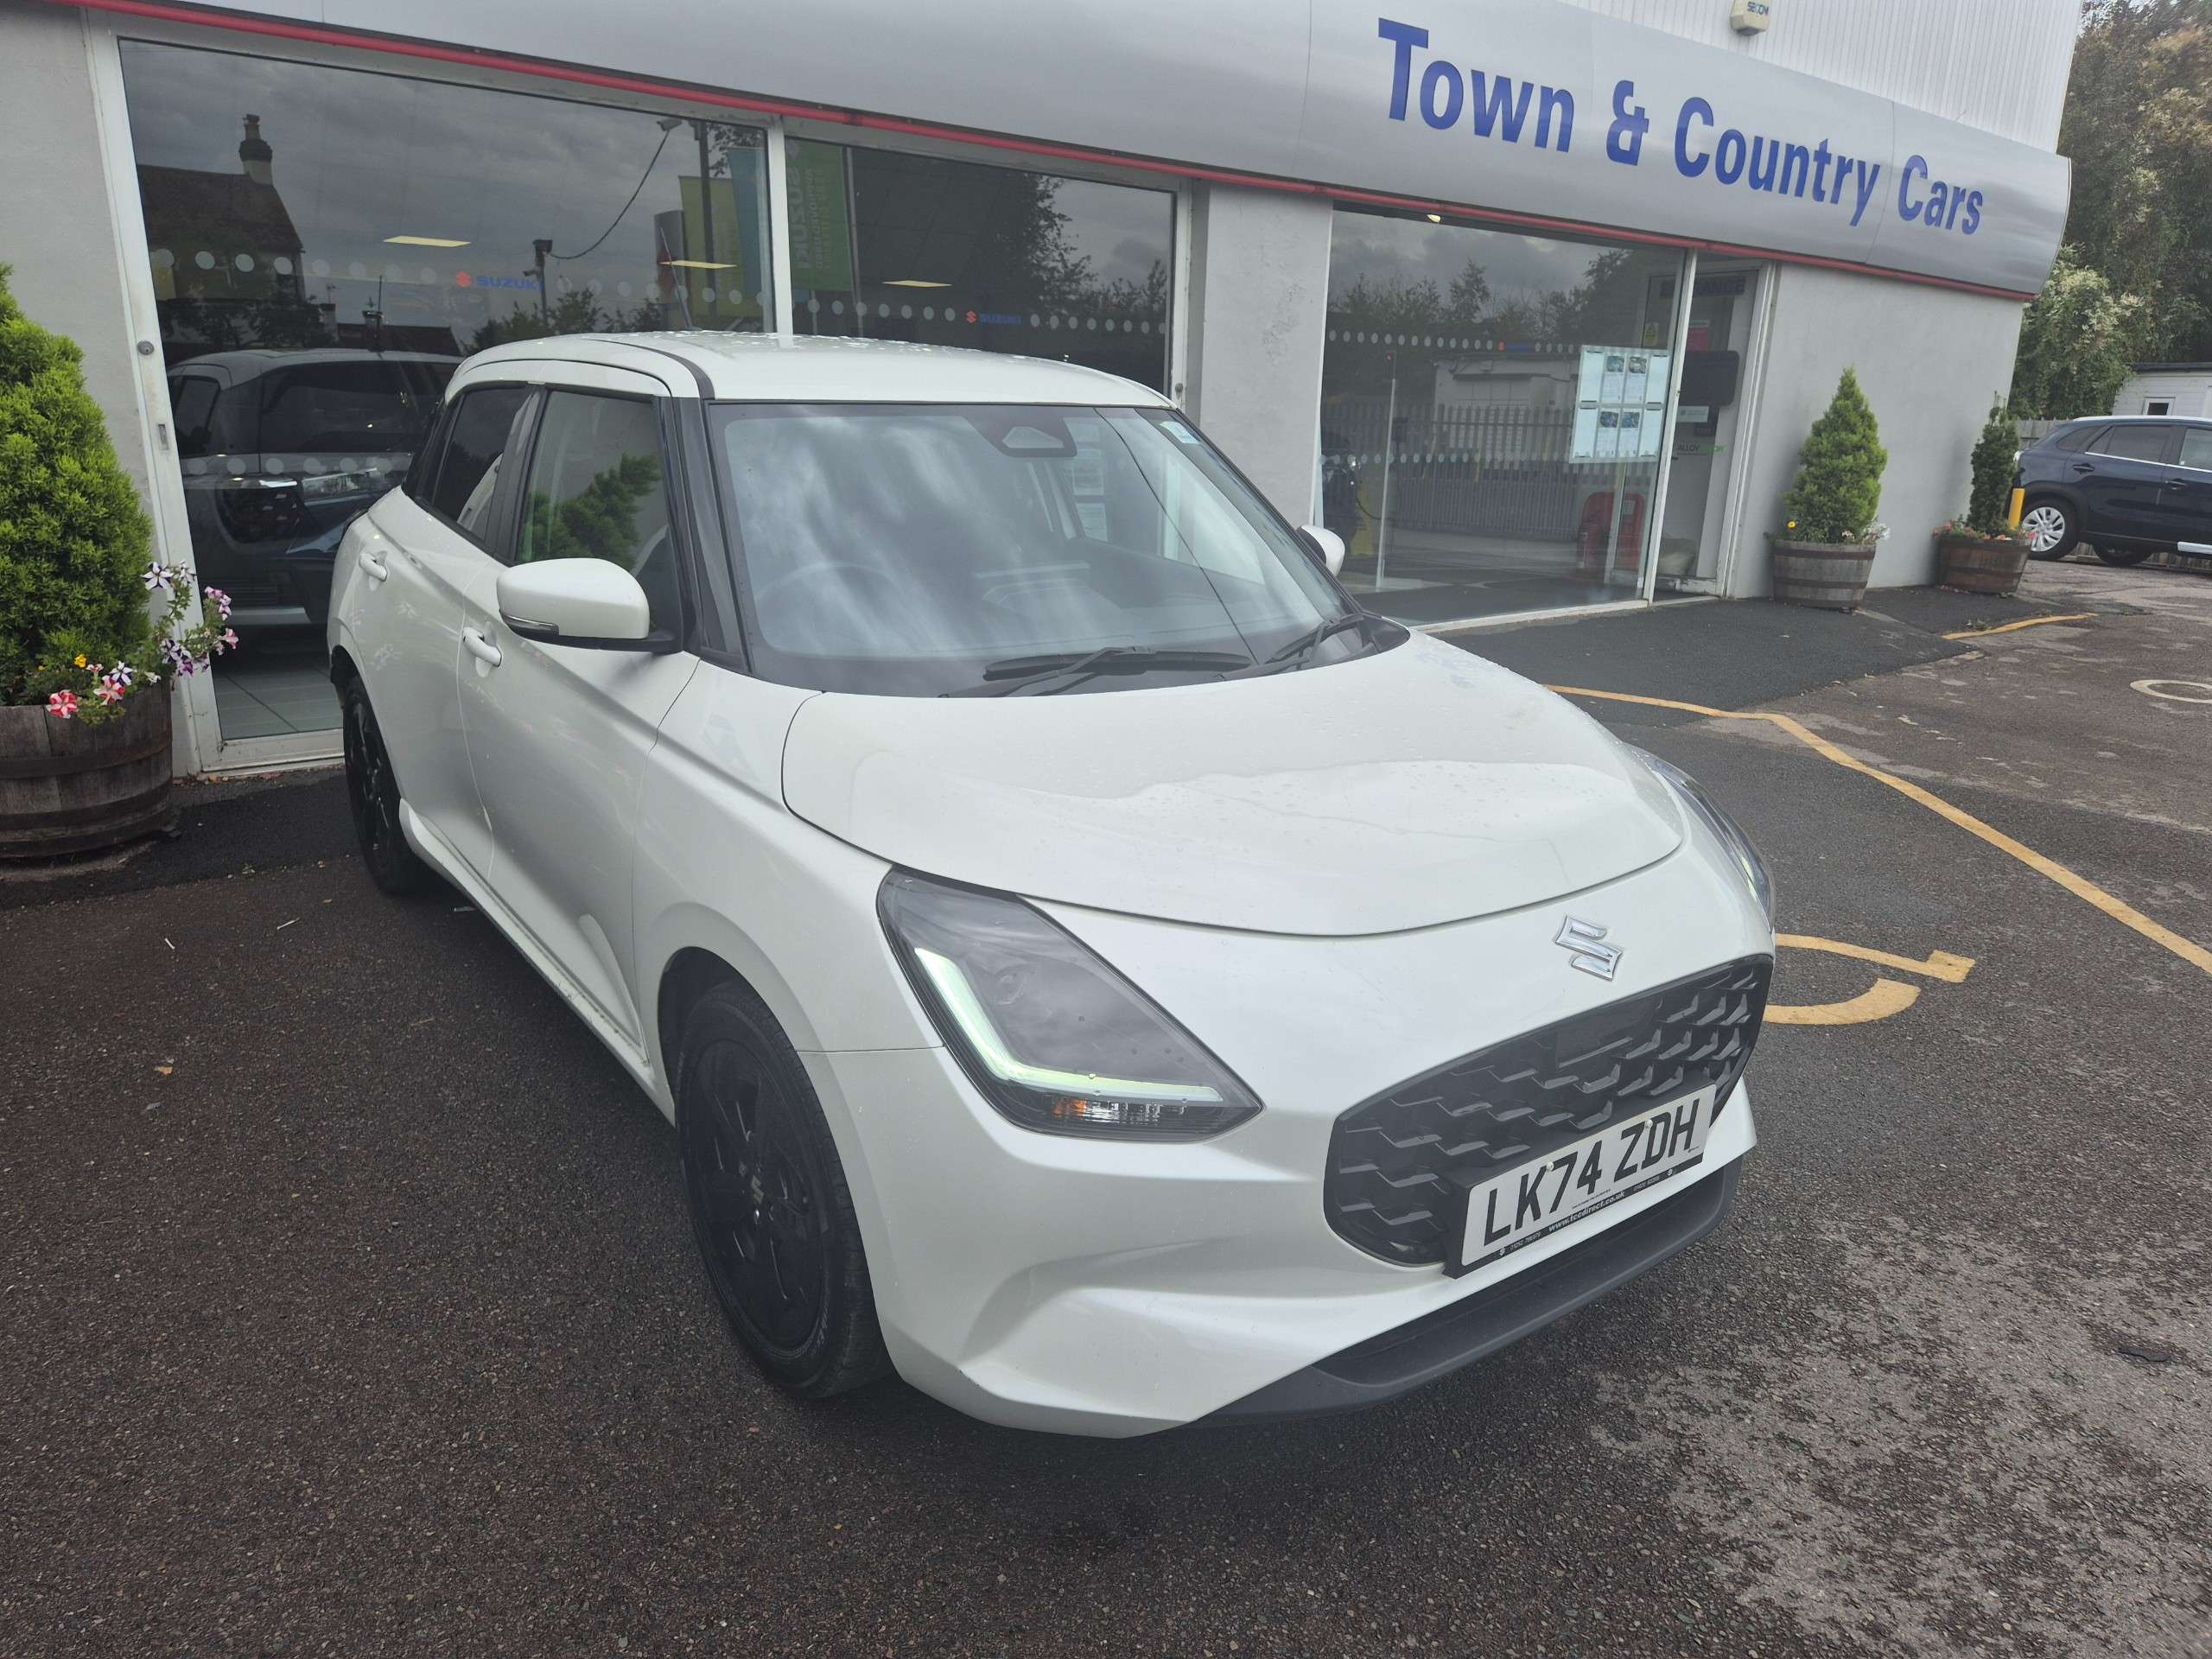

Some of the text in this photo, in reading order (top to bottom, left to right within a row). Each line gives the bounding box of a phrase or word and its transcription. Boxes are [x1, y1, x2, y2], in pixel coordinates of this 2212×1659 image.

[1378, 17, 1983, 235] Town & Country Cars
[476, 276, 543, 290] SUZUKI
[1484, 1098, 1700, 1247] LK74 ZDH
